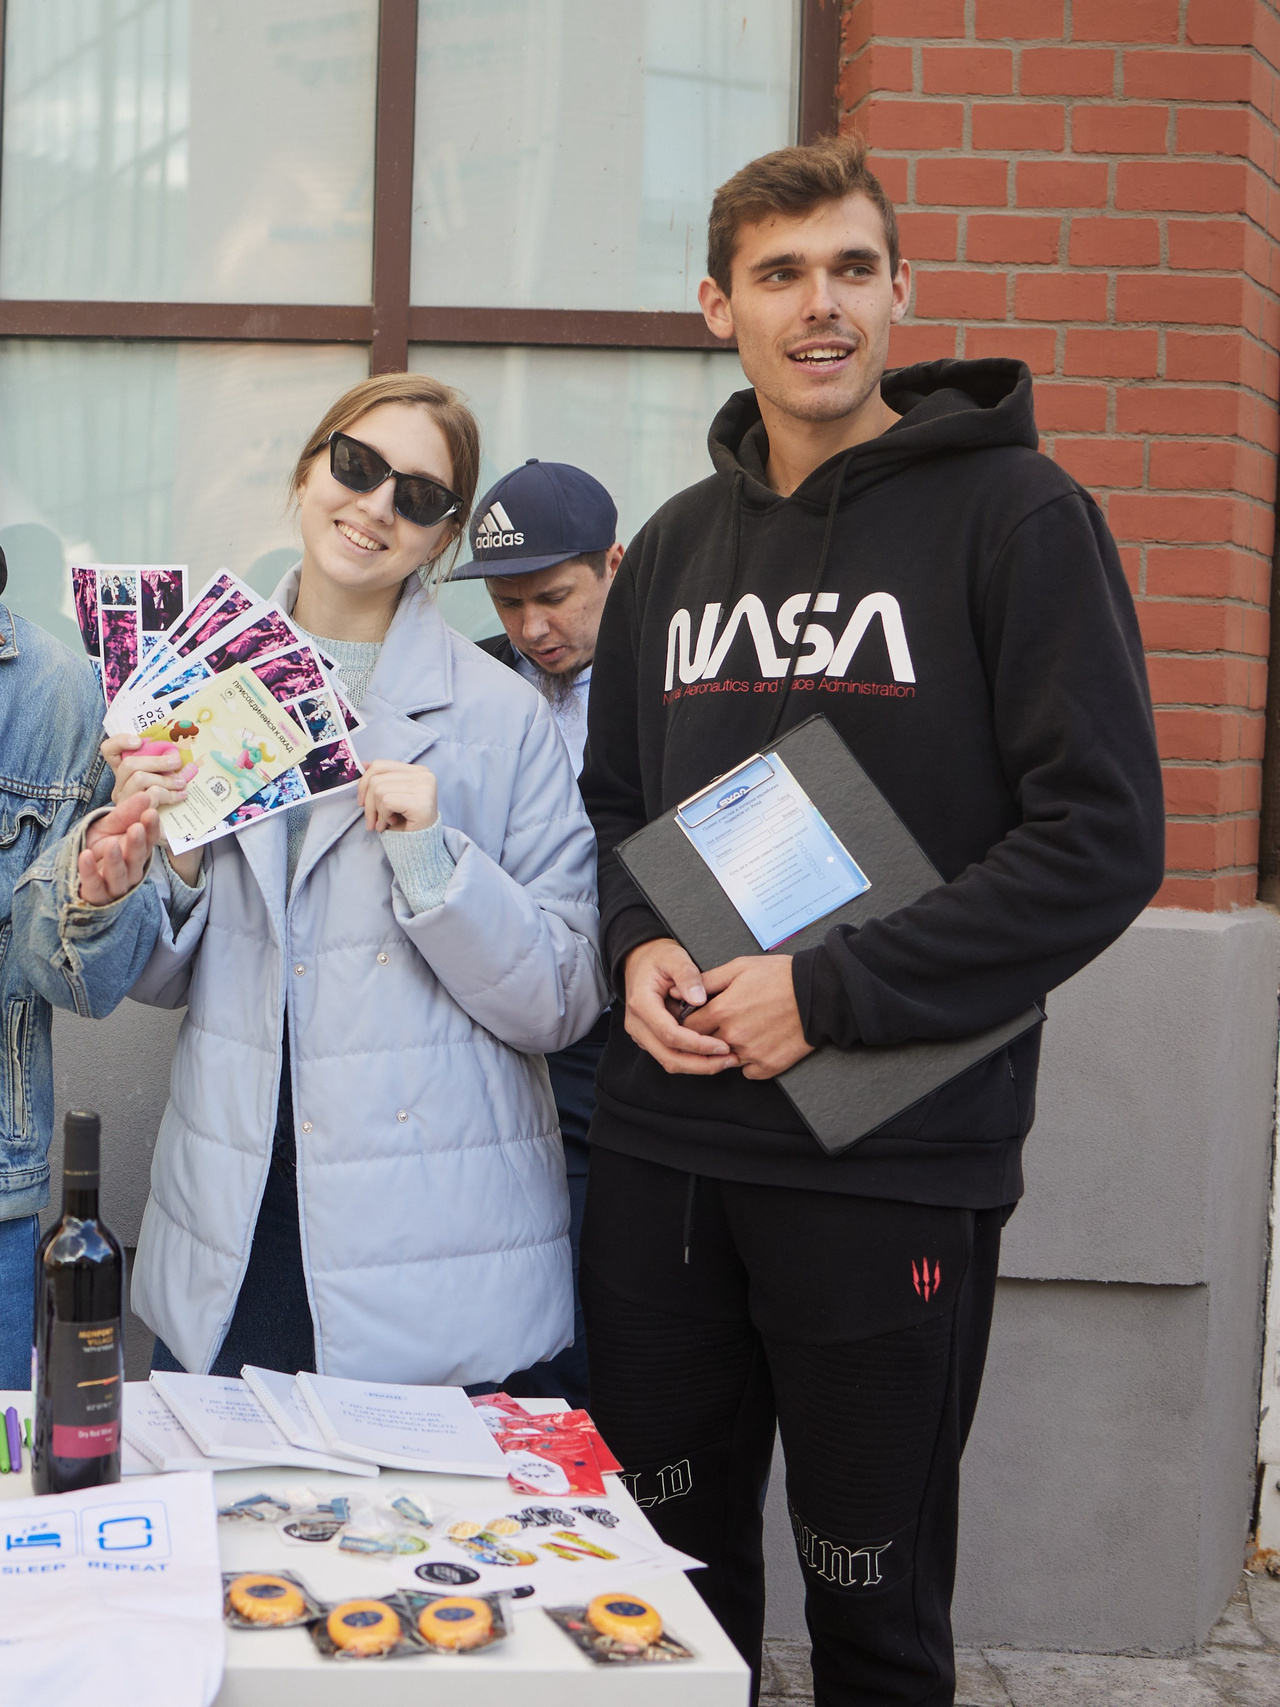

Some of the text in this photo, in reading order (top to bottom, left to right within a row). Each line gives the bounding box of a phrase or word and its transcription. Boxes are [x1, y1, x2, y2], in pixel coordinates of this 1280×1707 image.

[475, 530, 525, 549] adidas
[664, 591, 917, 692] NASA
[682, 678, 750, 698] Aeronautics
[753, 679, 779, 693] and
[819, 677, 916, 698] Administration
[232, 680, 277, 732] ПРИСОЕДИНЯЙСЯ
[278, 734, 294, 754] ЯХАД
[1, 1562, 67, 1576] SLEEP
[87, 1560, 170, 1573] REPEAT
